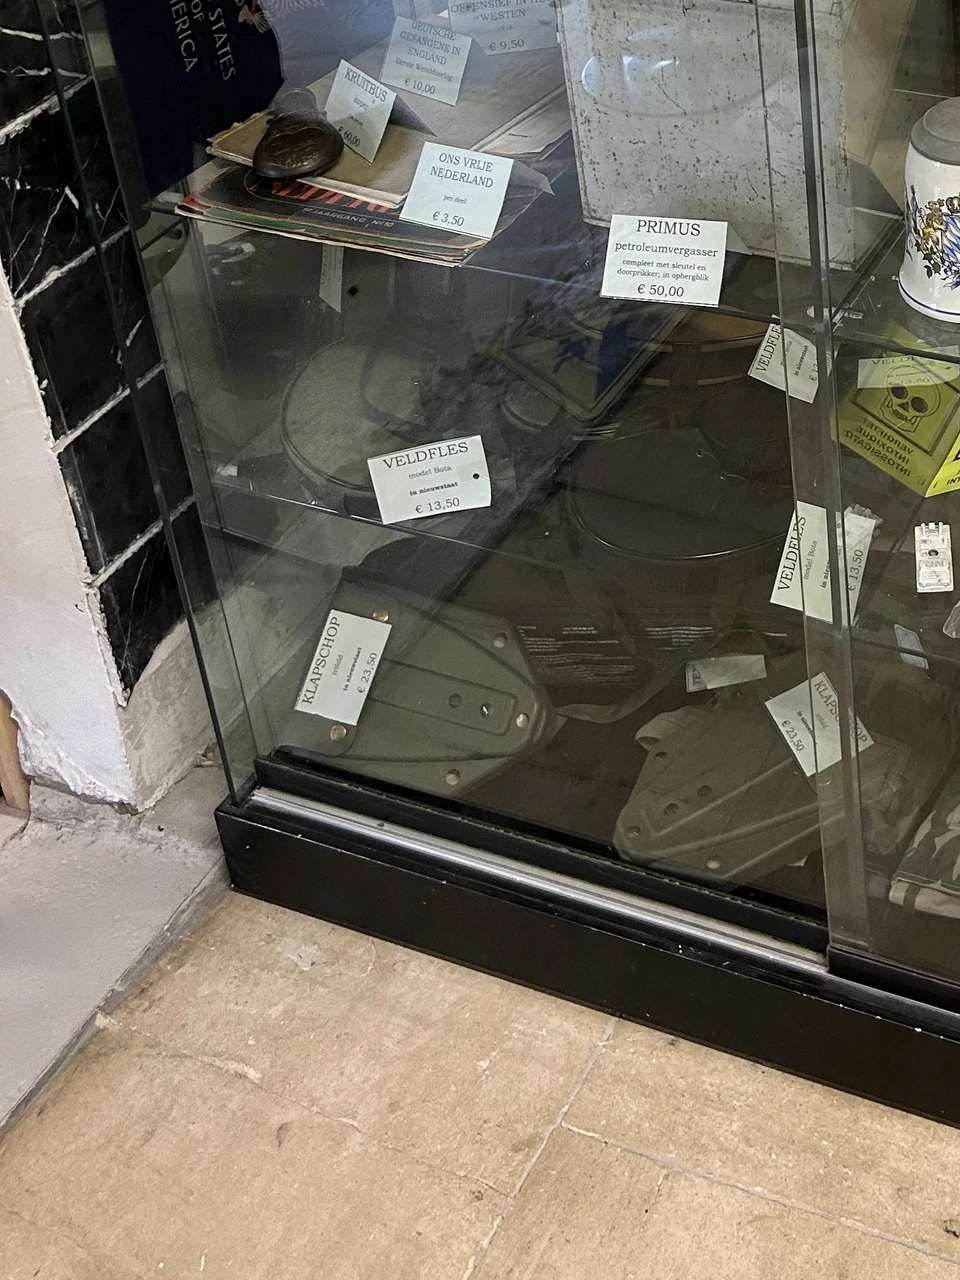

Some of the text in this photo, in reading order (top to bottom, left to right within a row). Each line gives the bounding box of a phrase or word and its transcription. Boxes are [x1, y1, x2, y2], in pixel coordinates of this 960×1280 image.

[190, 0, 205, 21] OF
[479, 8, 526, 22] WESTEN
[411, 21, 457, 41] DEUTSCHE
[208, 7, 237, 81] STATES
[407, 48, 447, 66] ENGLAND
[344, 67, 388, 103] KRUITBUS
[438, 152, 494, 172] ONS VRIJE
[430, 166, 494, 188] NEDERLAND
[432, 210, 465, 228] € 3,50
[636, 219, 701, 237] PRIMUS
[614, 242, 718, 258] petroleumvergasser
[622, 259, 655, 268] compleet
[656, 261, 670, 269] met
[671, 262, 695, 270] sleutel
[637, 283, 685, 298] € 50,00
[382, 441, 469, 469] VELDFLES
[408, 465, 453, 480] model Bota
[419, 481, 459, 494] nieuwstaat
[415, 497, 460, 514] € 13,50
[777, 515, 807, 591] VELDFLES
[803, 540, 818, 581] model Bota
[848, 549, 864, 581] 13,50
[301, 616, 341, 705] KLAPSCHOP
[360, 652, 378, 683] 23,50
[780, 720, 805, 752] € 23,50
